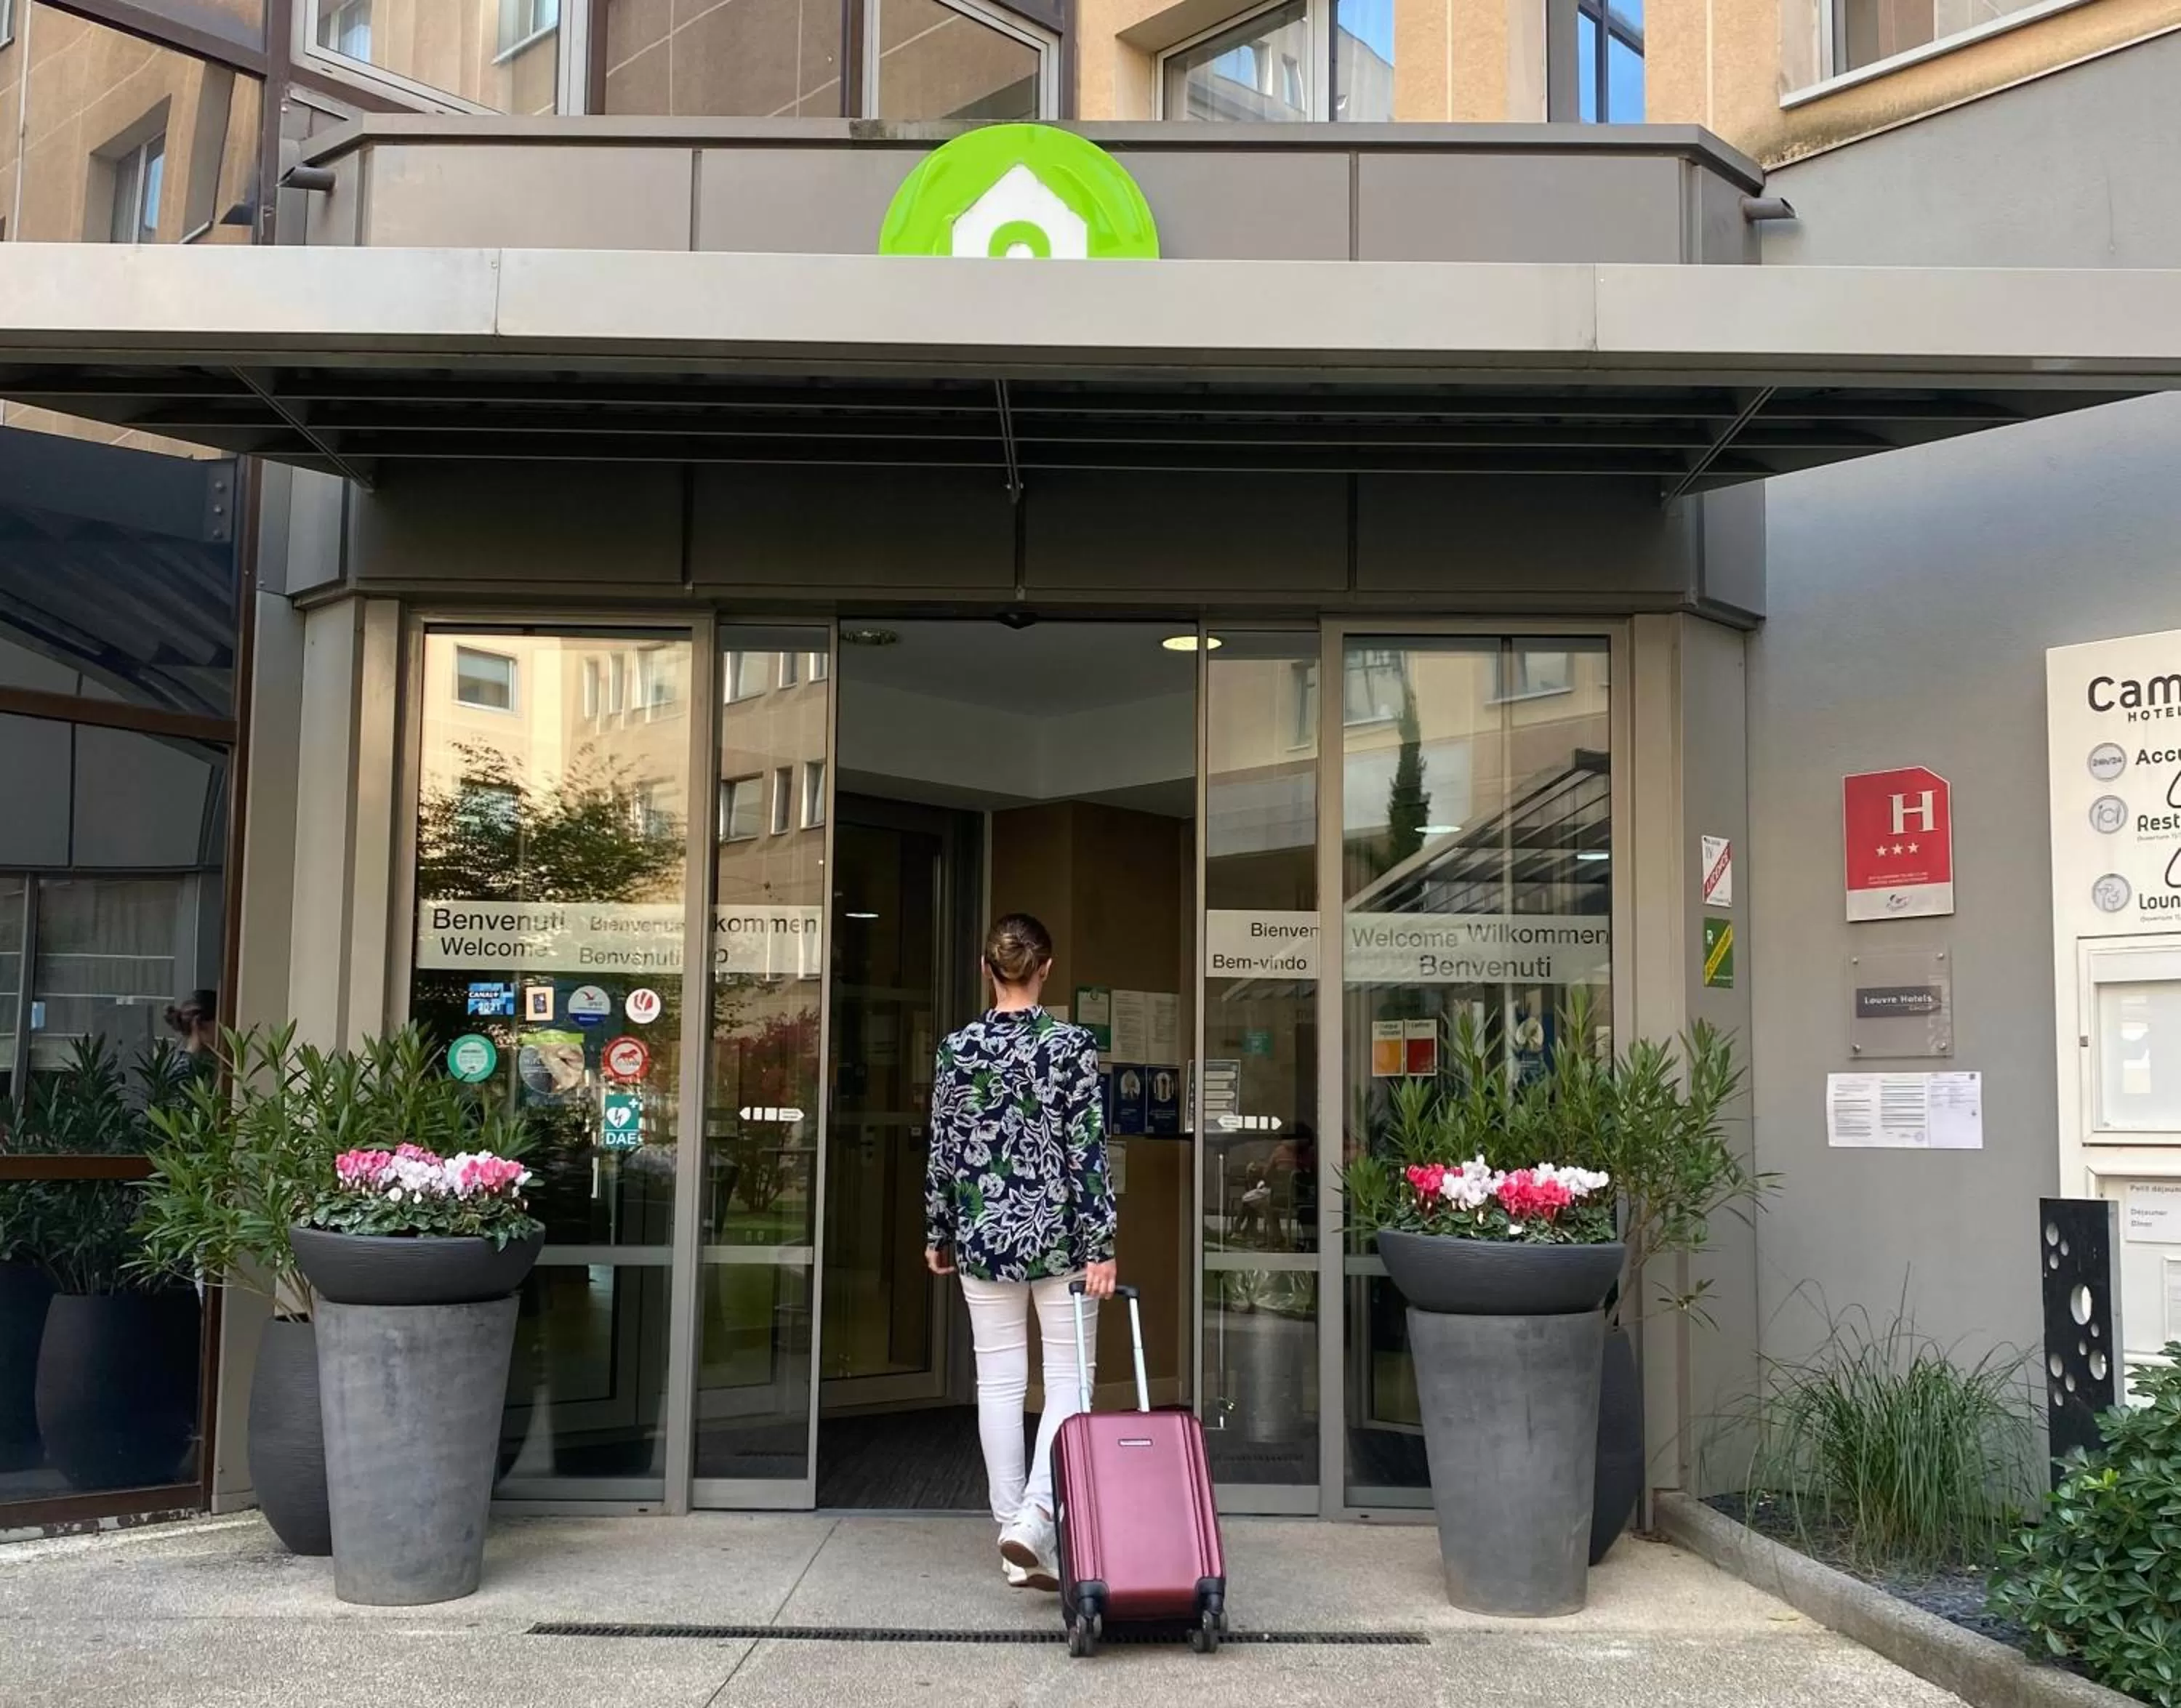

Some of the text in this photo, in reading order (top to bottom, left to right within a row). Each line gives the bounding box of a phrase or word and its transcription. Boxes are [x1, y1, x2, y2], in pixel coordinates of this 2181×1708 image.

[2088, 674, 2181, 712] Cam
[1887, 789, 1940, 835] H
[433, 909, 565, 931] Benvenuti
[1351, 927, 1458, 948] Welcome
[1213, 954, 1307, 970] Bem-vindo
[1419, 954, 1551, 978] Benvenuti
[606, 1132, 637, 1145] DAE
